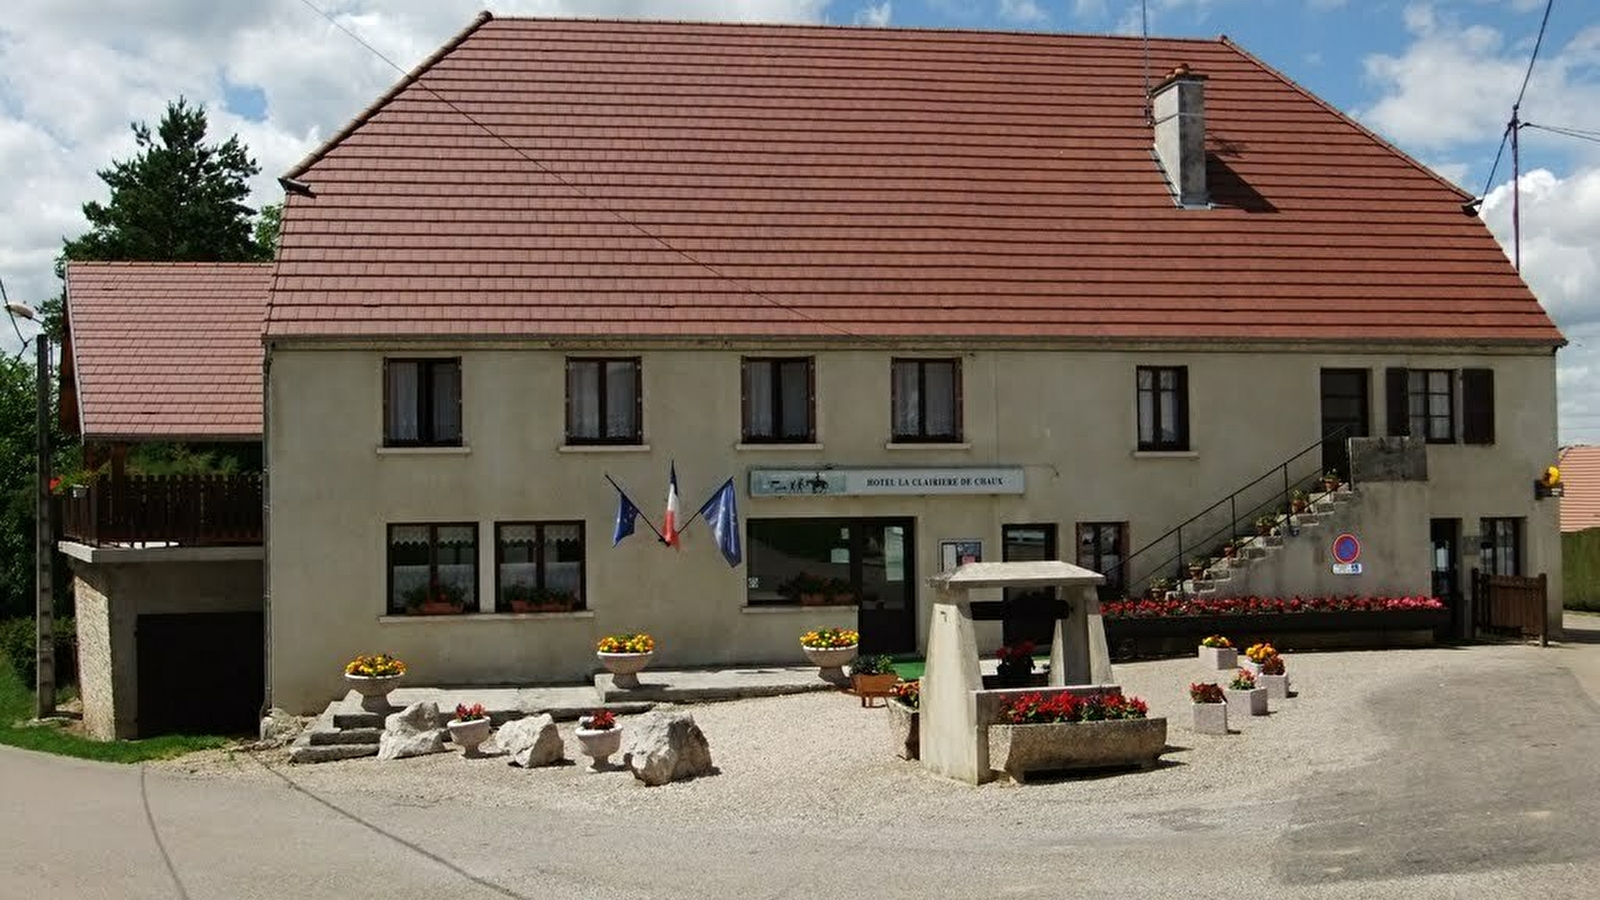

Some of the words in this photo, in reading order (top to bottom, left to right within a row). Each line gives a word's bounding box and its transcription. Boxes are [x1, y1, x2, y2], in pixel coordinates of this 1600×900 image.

[898, 477, 910, 487] LA
[960, 477, 973, 486] DE
[974, 476, 1004, 486] CHAUX
